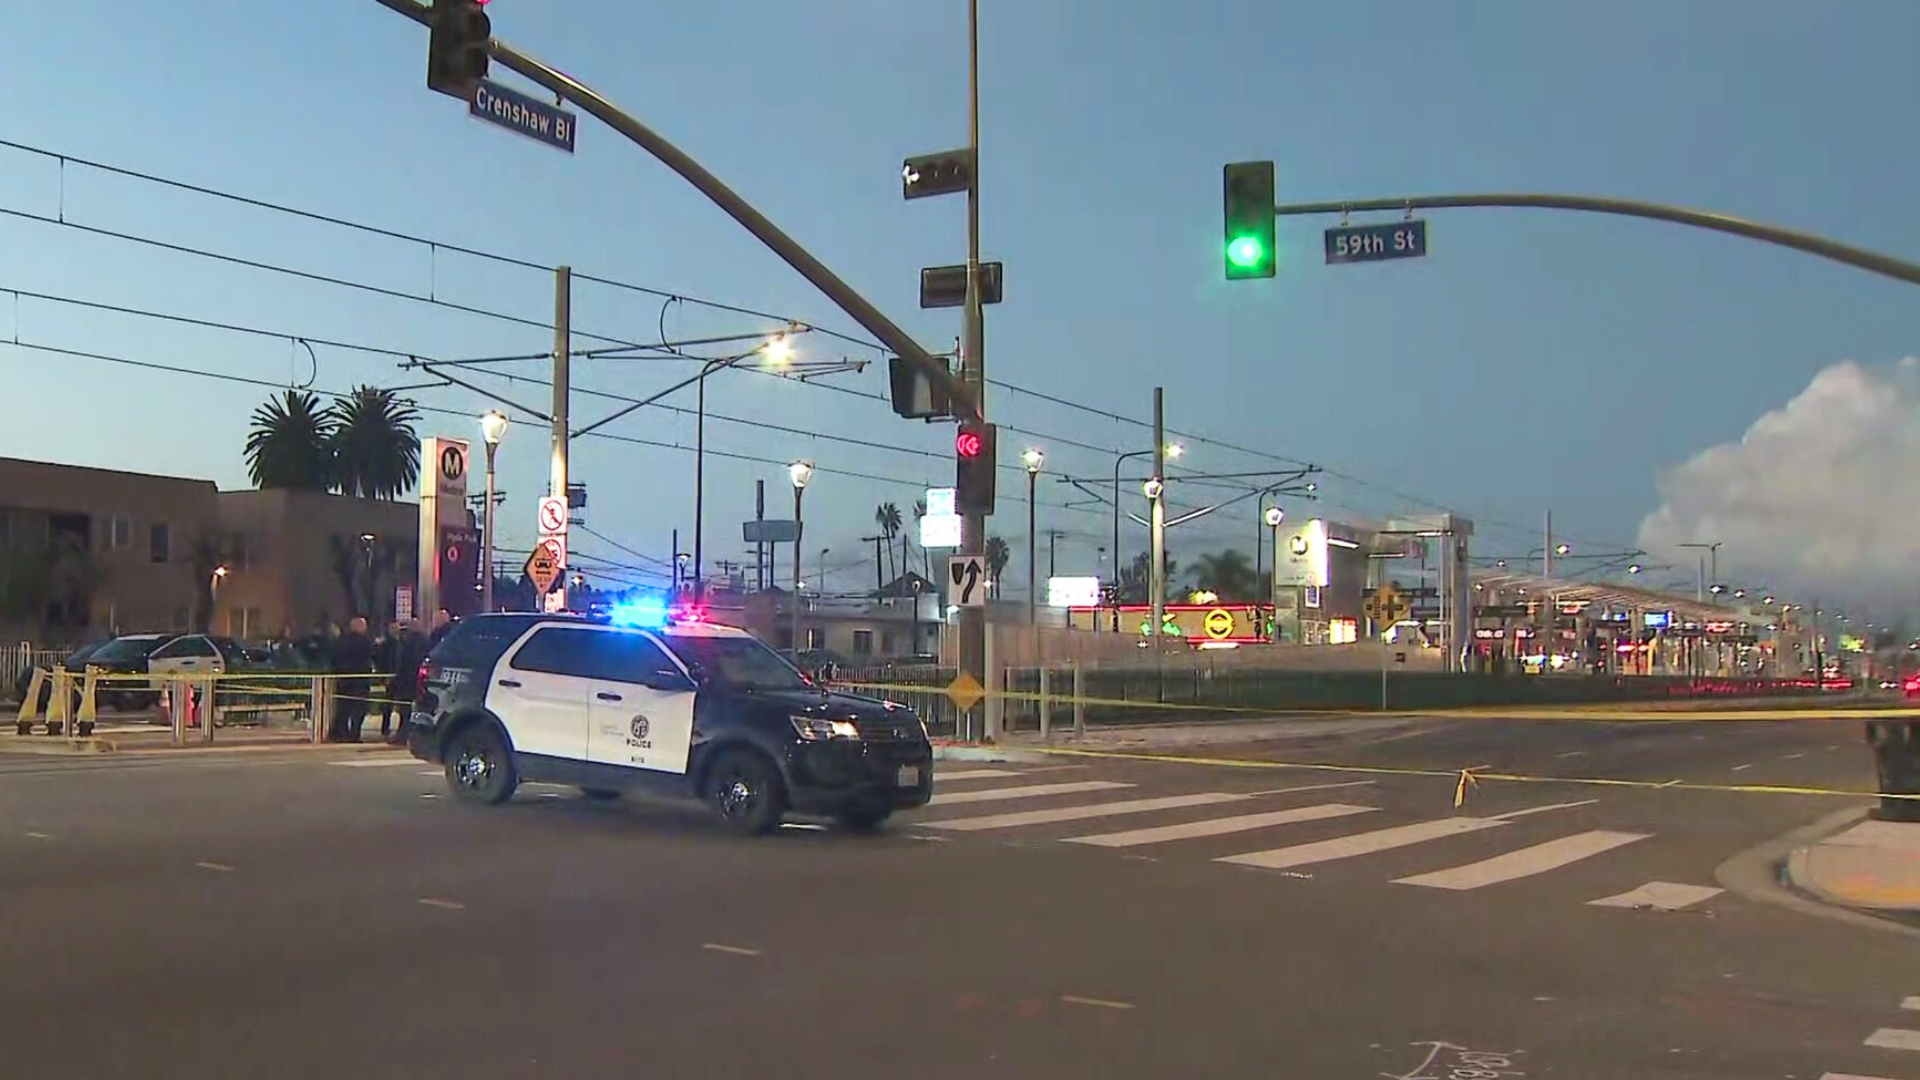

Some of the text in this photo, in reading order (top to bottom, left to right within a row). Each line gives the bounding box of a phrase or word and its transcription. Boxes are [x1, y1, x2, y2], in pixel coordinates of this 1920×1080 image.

[476, 87, 571, 142] Crenshaw Bl
[1336, 230, 1415, 256] 59th St
[445, 451, 460, 475] M
[626, 738, 652, 749] POLICE
